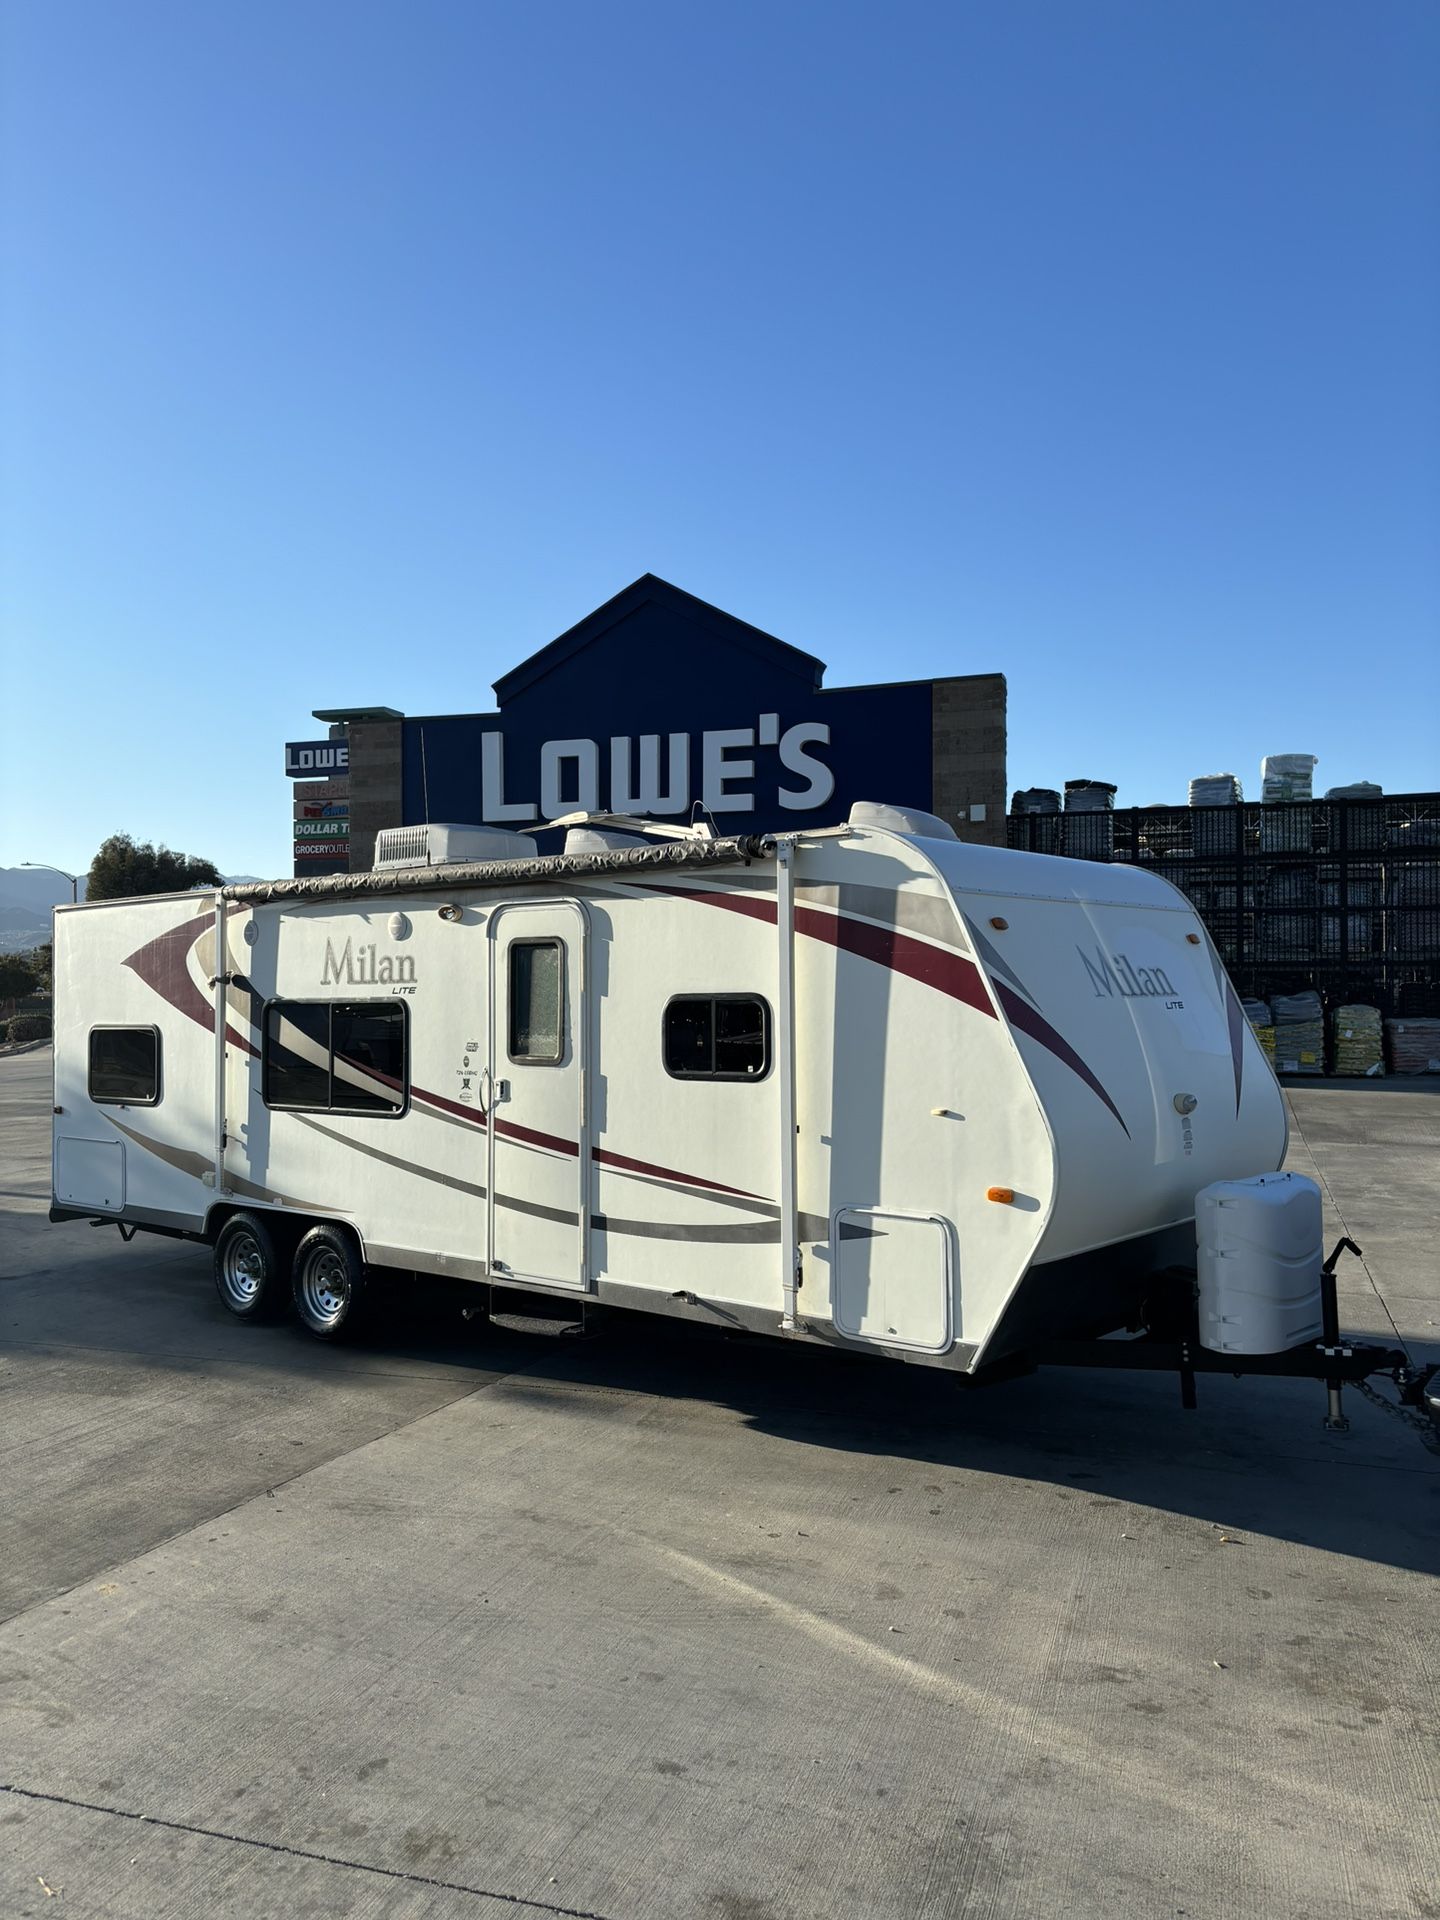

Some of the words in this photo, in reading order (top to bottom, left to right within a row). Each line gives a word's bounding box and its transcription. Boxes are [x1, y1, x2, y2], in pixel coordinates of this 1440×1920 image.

[286, 748, 349, 769] LOWE
[481, 712, 835, 822] LOWE'S
[295, 824, 338, 835] DOLLAR
[320, 935, 418, 986] Milan
[1075, 944, 1179, 998] Milan
[392, 986, 417, 995] LITE
[1165, 1001, 1184, 1010] LITE
